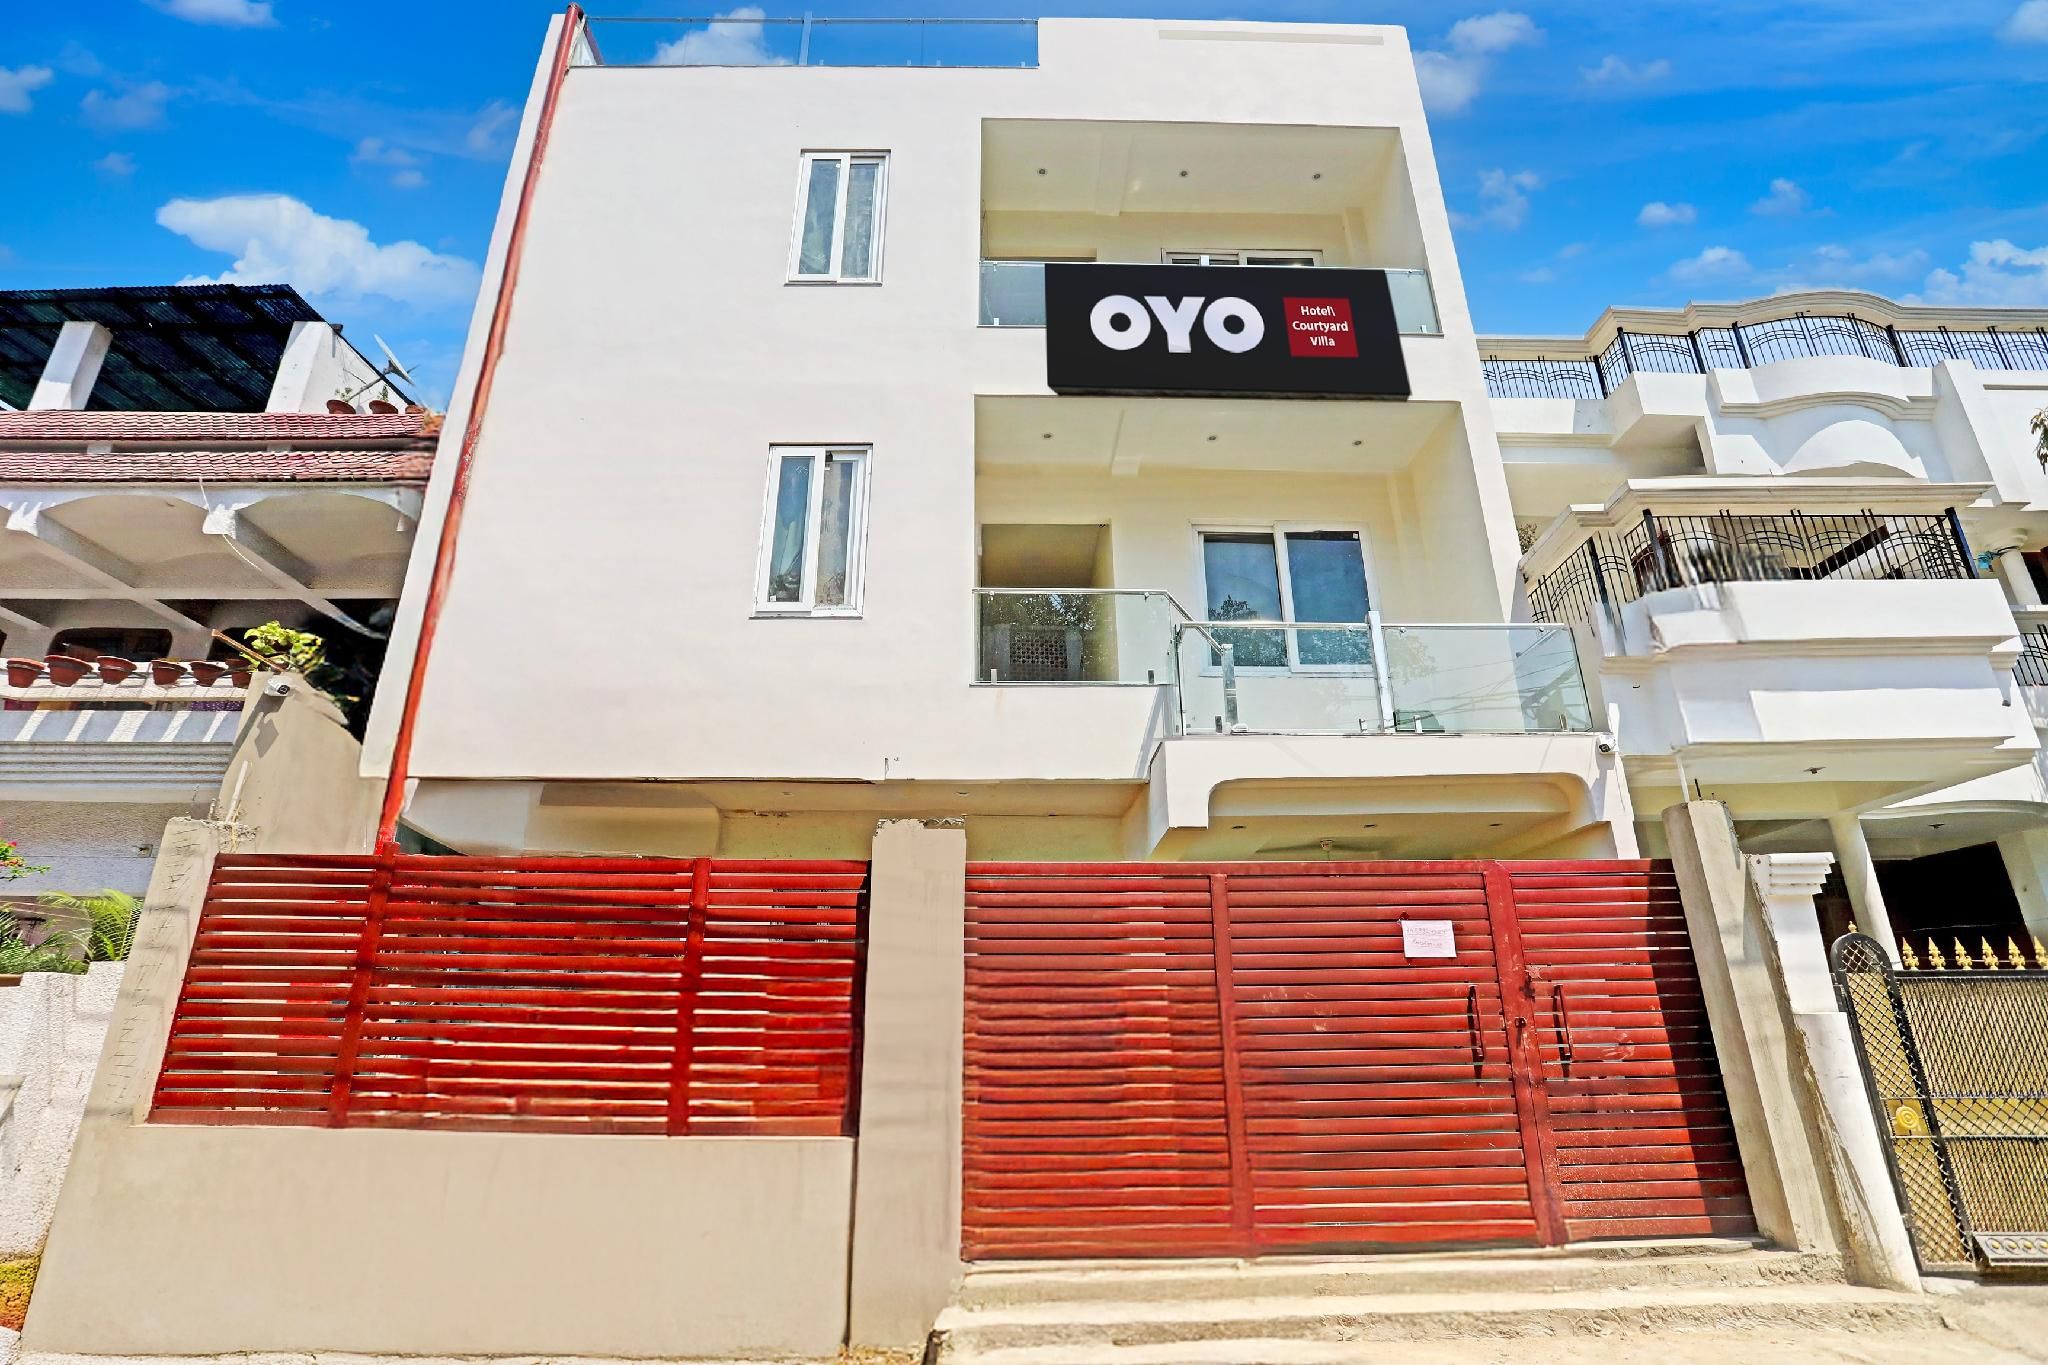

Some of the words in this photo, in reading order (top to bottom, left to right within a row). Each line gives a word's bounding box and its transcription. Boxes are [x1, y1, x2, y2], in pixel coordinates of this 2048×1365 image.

[1090, 295, 1265, 353] OYO
[1292, 321, 1349, 333] Courtyard
[1310, 335, 1336, 347] Villa
